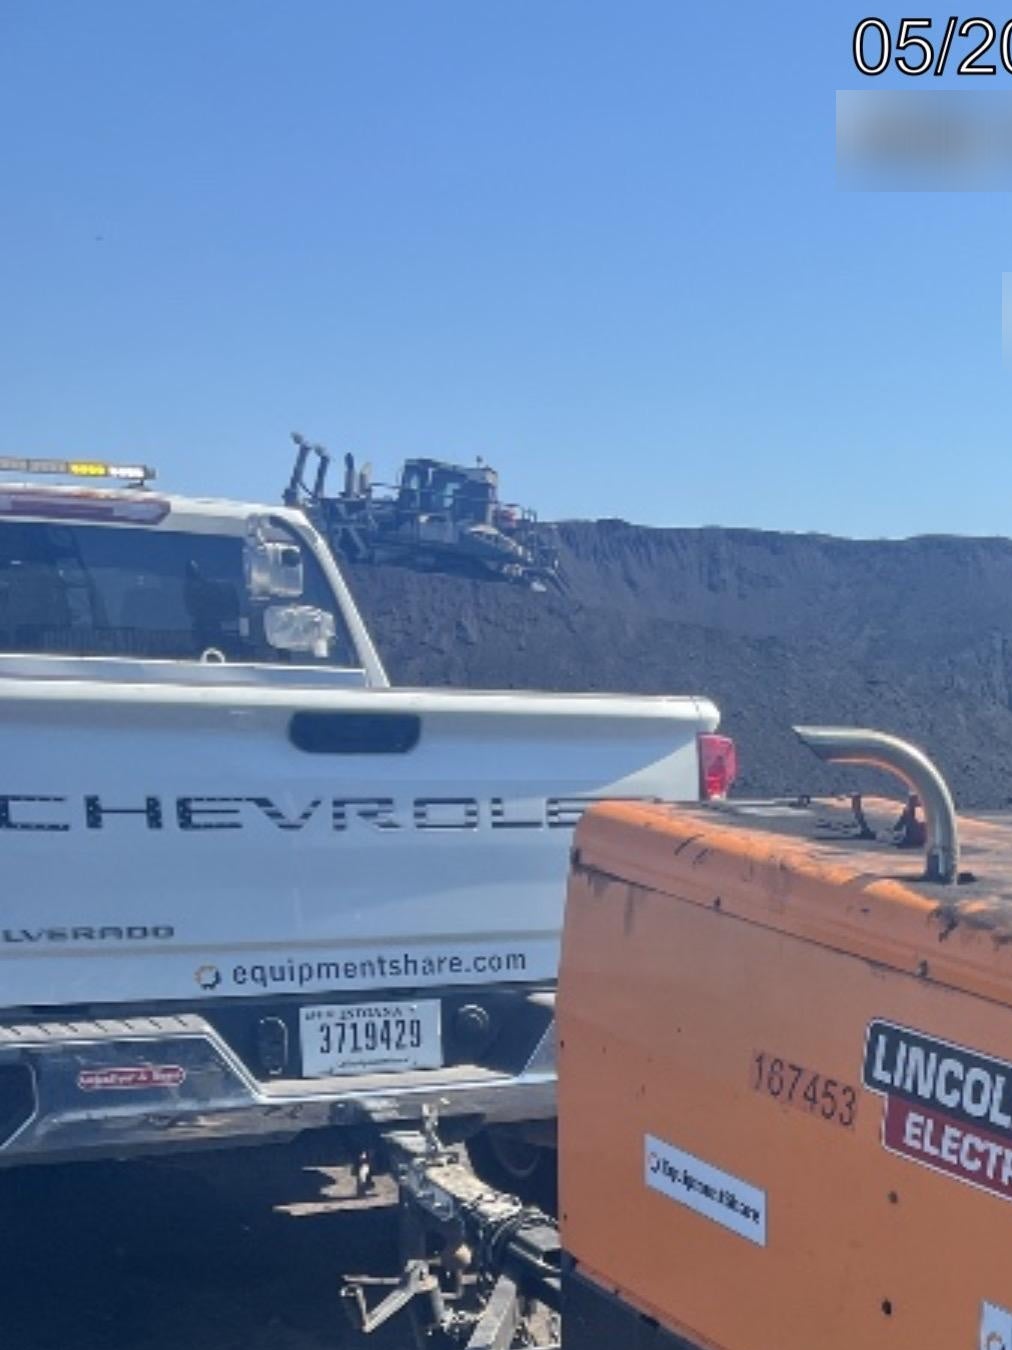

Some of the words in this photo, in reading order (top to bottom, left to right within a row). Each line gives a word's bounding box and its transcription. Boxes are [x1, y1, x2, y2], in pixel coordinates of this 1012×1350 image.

[232, 952, 527, 988] equipmentshare.com
[319, 1018, 422, 1054] 3719429
[754, 1053, 857, 1127] 167453
